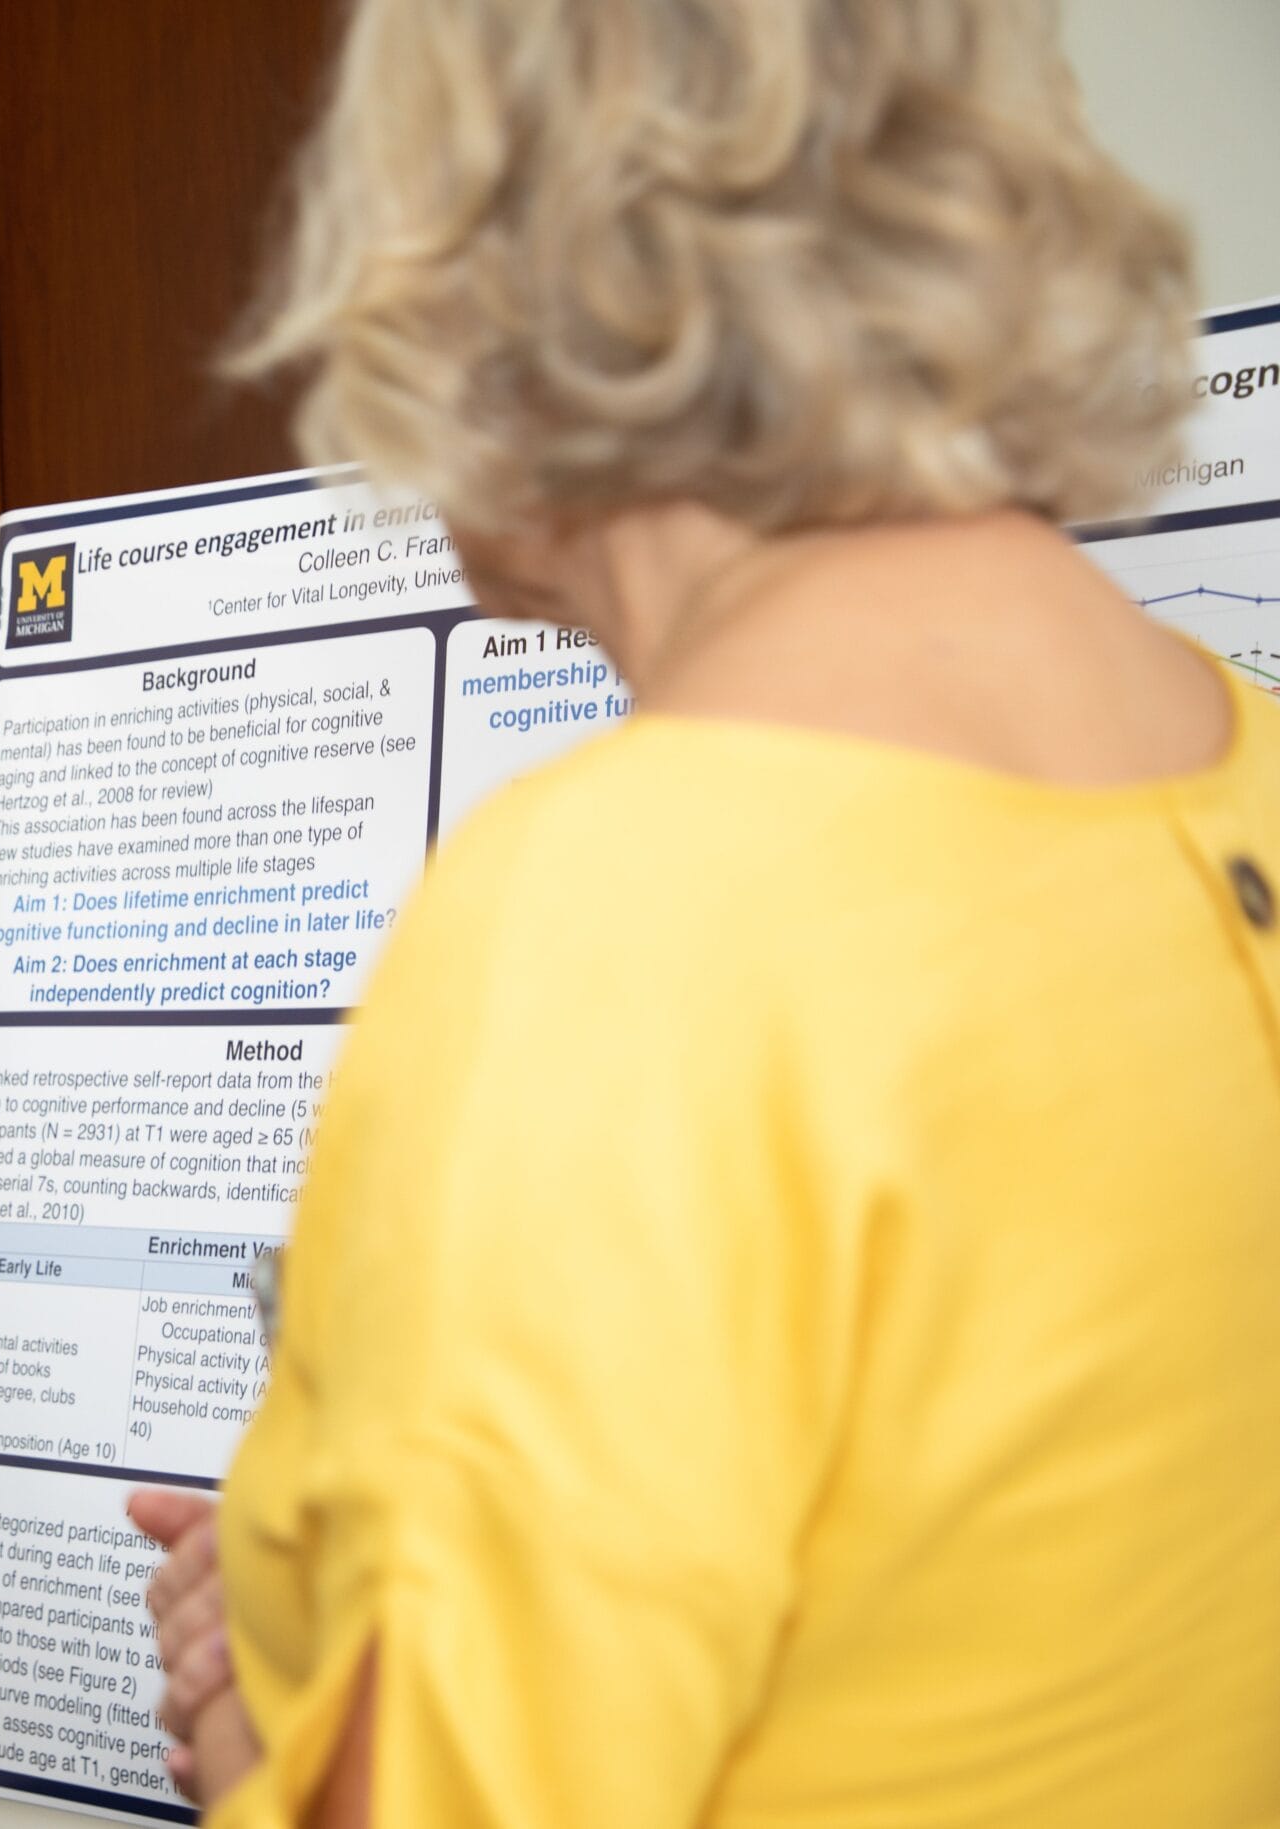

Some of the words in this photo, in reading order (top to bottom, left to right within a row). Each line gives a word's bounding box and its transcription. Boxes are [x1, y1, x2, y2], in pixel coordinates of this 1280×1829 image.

[78, 546, 112, 576] Life
[118, 540, 188, 567] course
[194, 514, 336, 557] engagement
[342, 508, 366, 532] in
[298, 548, 370, 573] Colleen
[377, 540, 396, 561] C.
[16, 554, 68, 614] M
[266, 591, 286, 608] for
[291, 584, 324, 605] Vital
[329, 574, 407, 601] Longevity,
[15, 620, 65, 637] MICHIGAN
[16, 612, 54, 625] UNIVERSITY
[56, 610, 66, 619] OF
[482, 634, 526, 658] Aim
[536, 630, 544, 651] 1
[142, 657, 256, 691] Background
[462, 660, 607, 696] membership
[3, 716, 89, 736] Participation
[93, 714, 106, 727] in
[110, 705, 173, 726] enriching
[177, 696, 239, 719] activities
[244, 686, 316, 715] (physical,
[322, 680, 373, 703] social,
[379, 678, 390, 697] &
[489, 698, 597, 732] cognitive
[0, 742, 51, 760] mental)
[56, 741, 82, 756] has
[86, 738, 122, 754] been
[126, 729, 165, 750] found
[170, 729, 183, 746] to
[187, 727, 205, 744] be
[209, 717, 280, 742] beneficial
[286, 715, 307, 734] for
[310, 710, 383, 734] cognitive
[38, 765, 66, 783] and
[70, 761, 113, 780] linked
[117, 762, 130, 777] to
[135, 758, 157, 776] the
[161, 752, 217, 773] concept
[221, 750, 235, 767] of
[239, 744, 308, 768] cognitive
[313, 740, 374, 759] reserve
[380, 735, 415, 757] (see
[24, 816, 105, 834] association
[110, 812, 136, 829] has
[141, 810, 177, 827] been
[182, 804, 222, 824] found
[226, 803, 276, 821] across
[281, 798, 306, 816] the
[311, 796, 374, 816] lifespan
[21, 842, 72, 859] studies
[77, 841, 113, 856] have
[117, 833, 189, 855] examined
[193, 834, 231, 850] more
[236, 829, 268, 847] than
[272, 828, 302, 845] one
[307, 824, 342, 847] type
[346, 820, 363, 840] of
[52, 867, 116, 883] activities
[121, 865, 170, 880] across
[175, 857, 232, 880] multiple
[236, 856, 258, 874] life
[262, 855, 315, 876] stages
[12, 894, 45, 912] Aim
[53, 894, 66, 911] 1:
[72, 892, 117, 910] Does
[123, 889, 188, 909] lifetime
[193, 883, 296, 906] enrichment
[301, 879, 368, 906] predict
[67, 919, 168, 942] functioning
[173, 916, 207, 937] and
[212, 914, 278, 936] decline
[284, 912, 300, 932] in
[307, 912, 349, 931] later
[355, 908, 396, 929] life?
[12, 955, 45, 973] Aim
[50, 955, 66, 973] 2:
[72, 954, 117, 972] Does
[123, 952, 226, 972] enrichment
[231, 951, 248, 970] at
[253, 948, 297, 969] each
[303, 948, 356, 972] stage
[29, 982, 155, 1006] independently
[160, 981, 225, 1005] predict
[230, 978, 330, 1004] cognition?
[226, 1039, 302, 1061] Method
[32, 1070, 128, 1090] retrospective
[133, 1070, 212, 1092] self-report
[216, 1071, 251, 1088] data
[256, 1071, 292, 1089] from
[298, 1072, 322, 1089] the
[5, 1096, 18, 1112] to
[22, 1097, 87, 1117] cognitive
[90, 1096, 188, 1117] performance
[193, 1098, 224, 1116] and
[228, 1099, 285, 1117] decline
[290, 1099, 306, 1121] (5
[38, 1175, 57, 1194] 7s,
[63, 1177, 127, 1200] counting
[131, 1178, 220, 1201] backwards,
[148, 1235, 246, 1259] Enrichment
[35, 1259, 62, 1277] Life
[141, 1295, 167, 1313] Job
[171, 1298, 257, 1320] enrichment/
[21, 1337, 78, 1356] activities
[161, 1321, 255, 1345] Occupational
[137, 1344, 196, 1367] Physical
[200, 1352, 250, 1374] activity
[134, 1369, 193, 1392] Physical
[197, 1377, 248, 1400] activity
[129, 1420, 152, 1441] 40)
[66, 1524, 156, 1552] participants
[32, 1660, 64, 1682] (see
[68, 1665, 117, 1692] Figure
[120, 1675, 136, 1700] 2)
[28, 1750, 57, 1772] age
[61, 1756, 76, 1774] at
[80, 1756, 106, 1782] T1,
[109, 1766, 168, 1793] gender,
